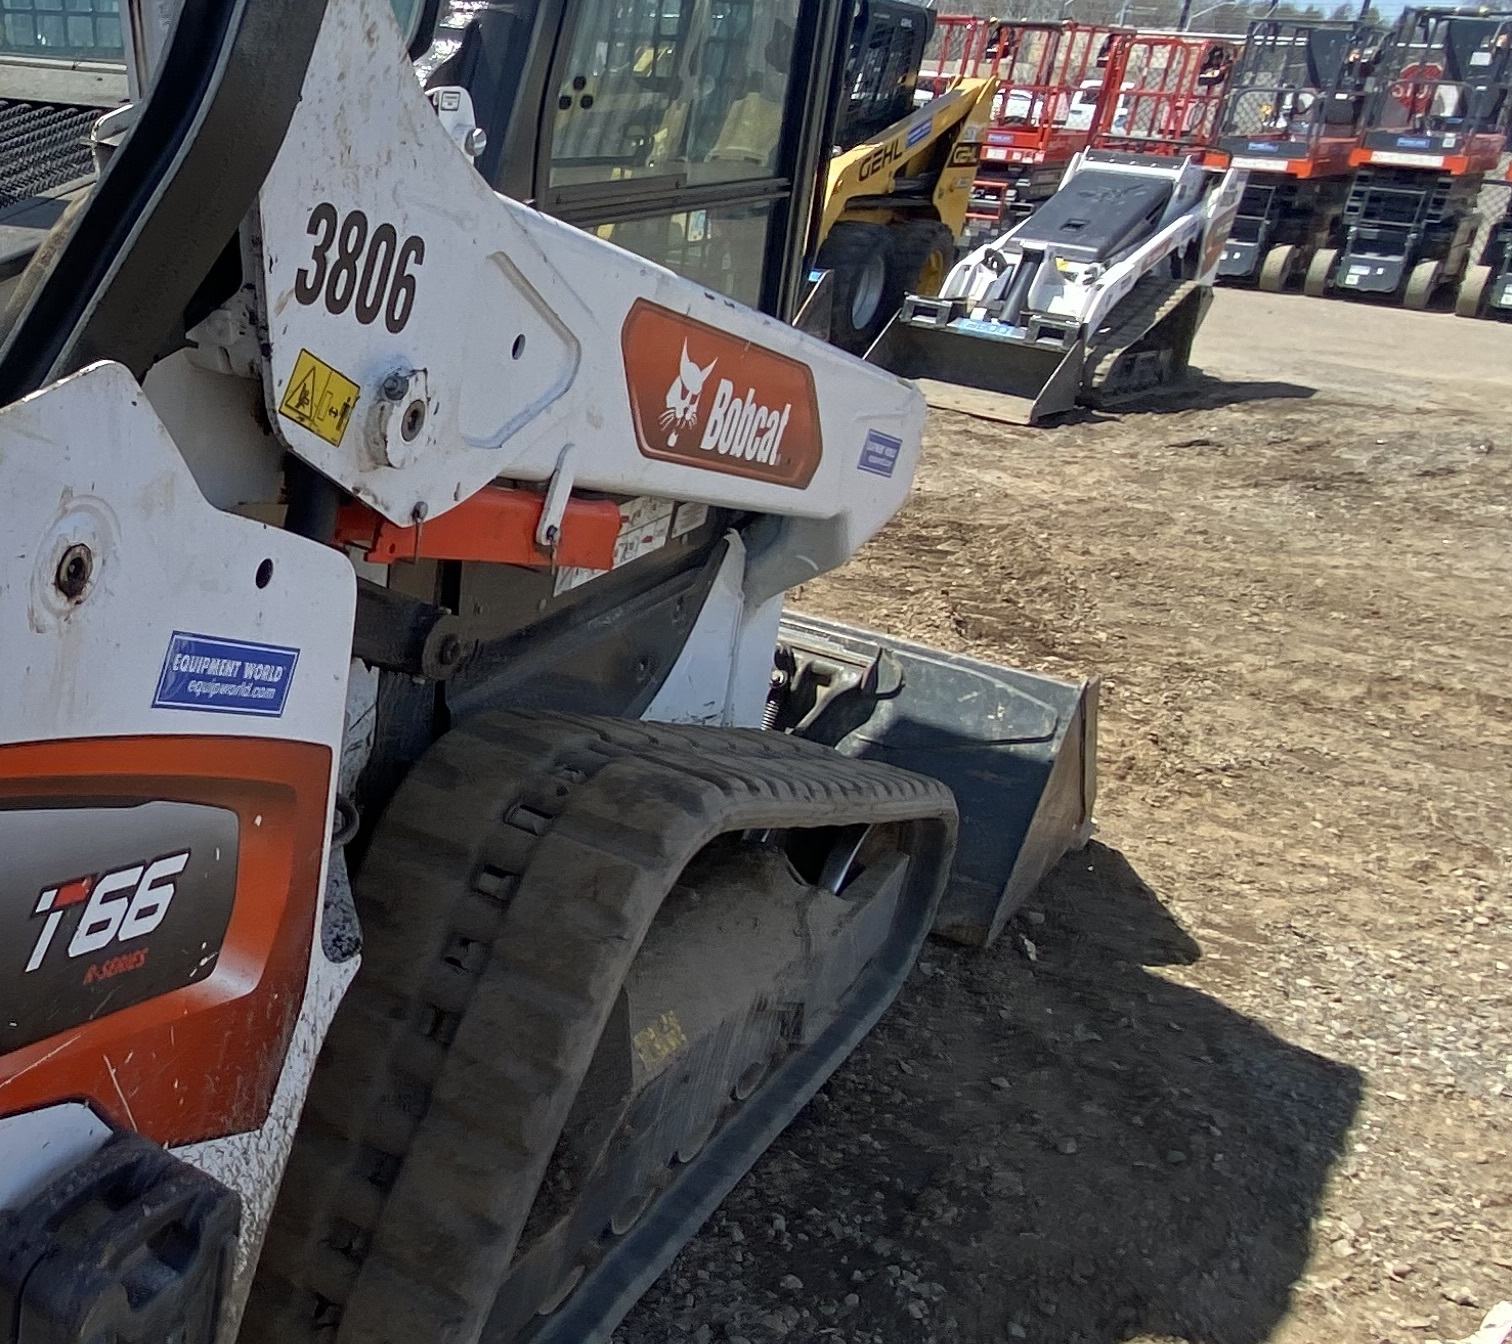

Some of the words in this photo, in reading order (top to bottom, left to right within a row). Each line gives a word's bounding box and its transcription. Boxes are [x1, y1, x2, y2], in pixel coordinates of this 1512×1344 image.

[858, 138, 903, 182] GEHL
[294, 202, 425, 334] 3806
[700, 378, 791, 466] Bobcat
[172, 653, 242, 678] EQUIPMENT
[243, 662, 283, 682] WORLD
[188, 679, 276, 699] equipworld.com
[25, 853, 189, 972] T66
